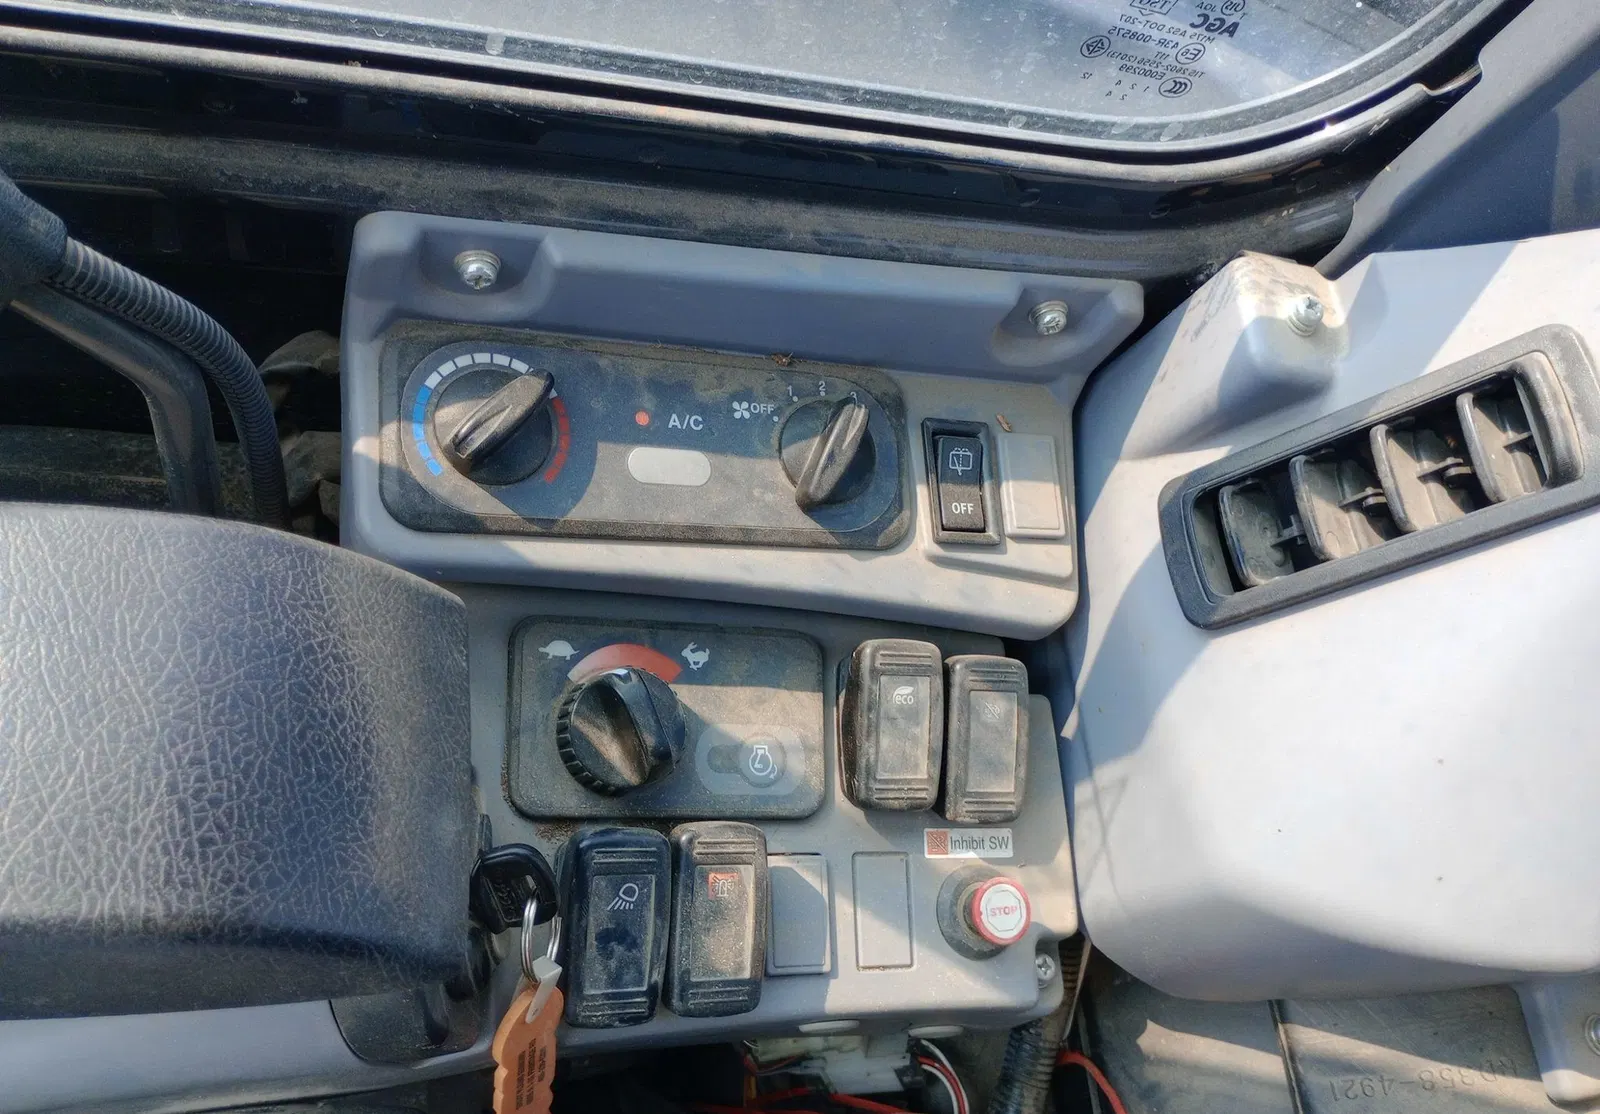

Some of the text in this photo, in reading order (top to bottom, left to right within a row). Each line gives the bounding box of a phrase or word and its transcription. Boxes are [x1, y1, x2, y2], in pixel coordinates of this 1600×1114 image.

[787, 385, 794, 397] 1
[818, 381, 826, 391] 2
[750, 402, 775, 415] OFF
[667, 413, 704, 431] A/C
[951, 502, 974, 515] OFF
[895, 695, 914, 705] eco
[950, 835, 1010, 851] Inhibit SW
[990, 905, 1019, 917] STOP
